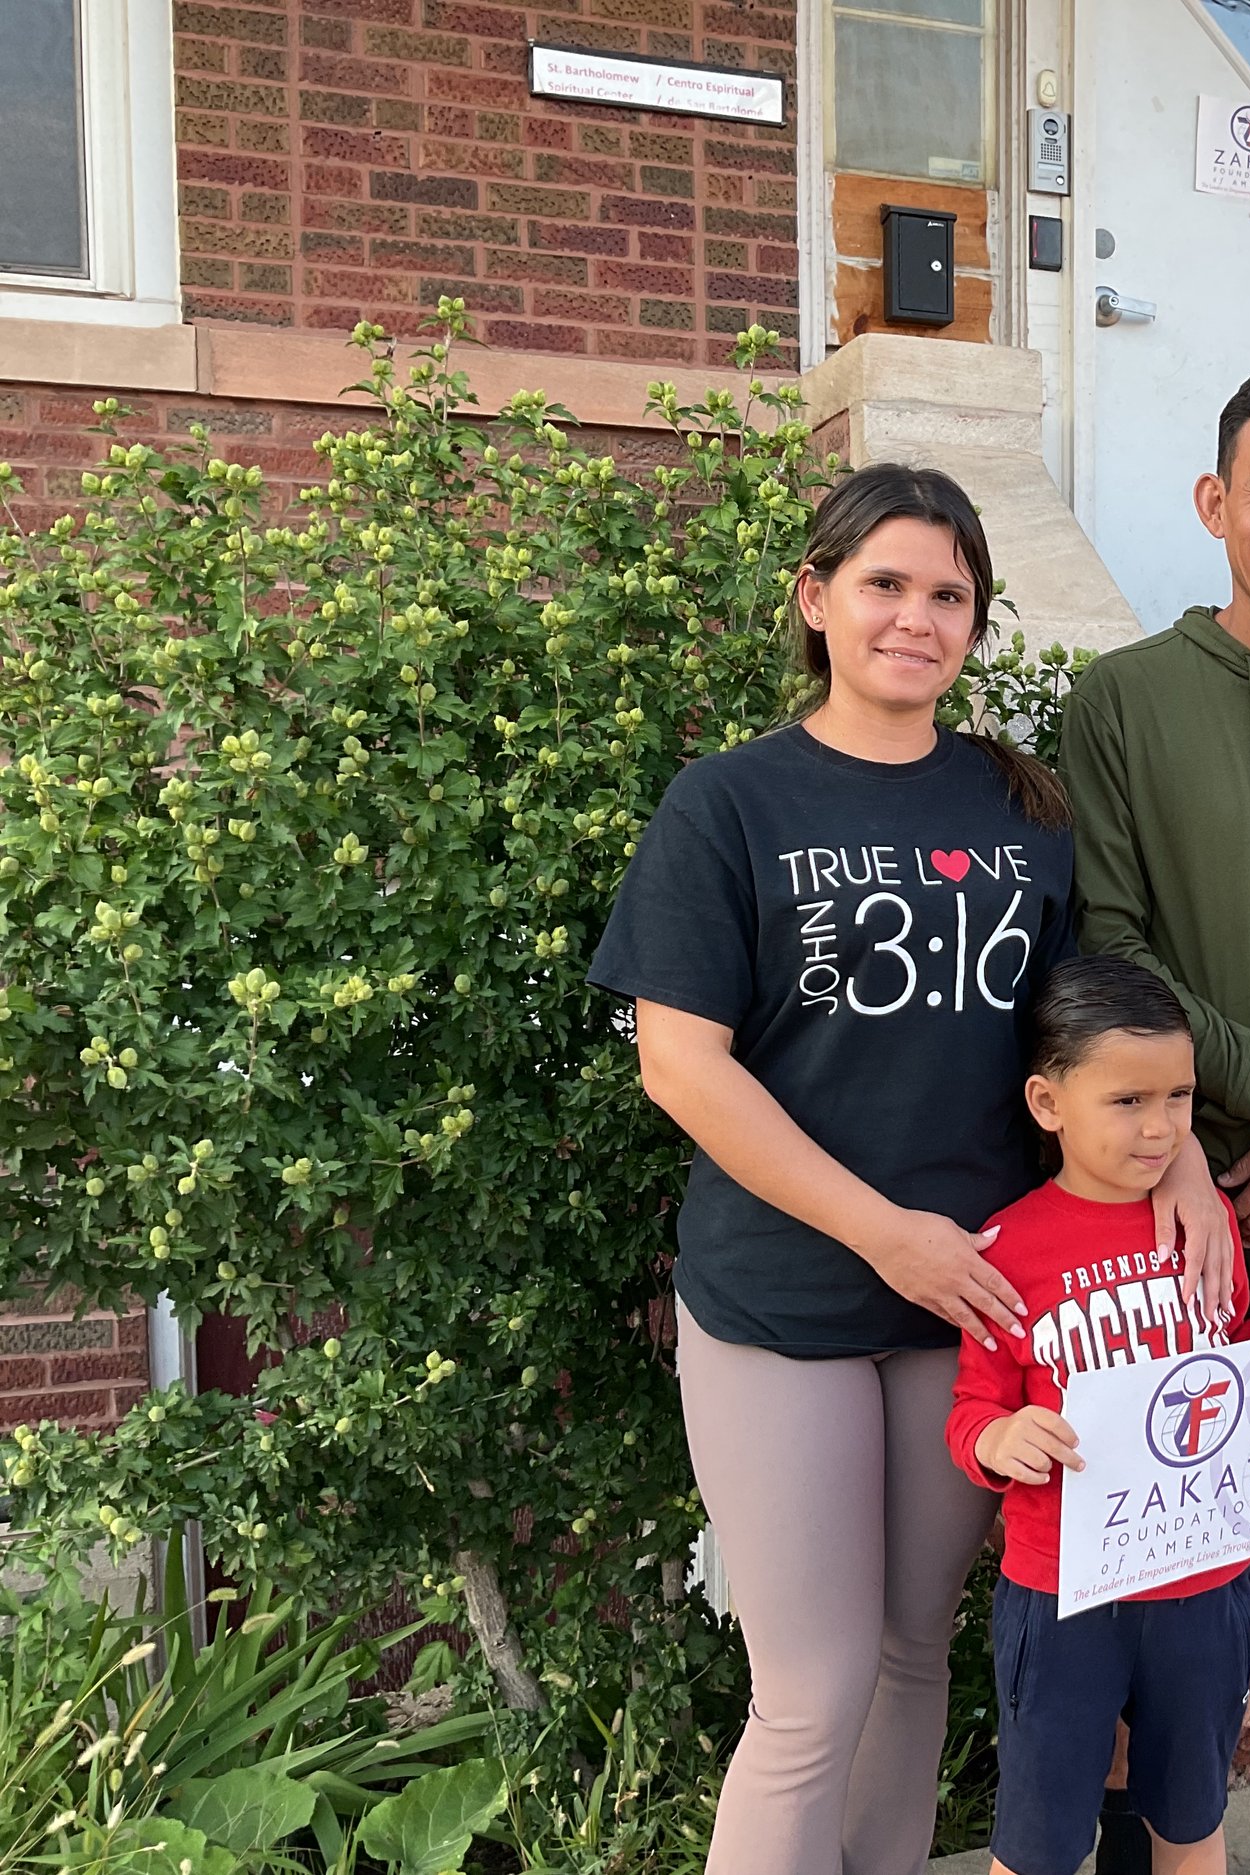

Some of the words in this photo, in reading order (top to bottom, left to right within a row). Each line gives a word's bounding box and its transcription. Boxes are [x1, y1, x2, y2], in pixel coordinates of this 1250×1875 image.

[547, 63, 562, 74] St.
[565, 65, 640, 83] Bartholomew
[667, 76, 703, 90] Centro
[706, 82, 755, 97] Espiritual
[548, 81, 594, 96] Spiritual
[779, 846, 901, 895] TRUE
[796, 900, 840, 1015] JOHN
[846, 889, 1030, 1015] 3:16
[1061, 1250, 1161, 1295] FRIENDS
[1073, 1588, 1090, 1602] The
[1091, 1578, 1124, 1597] Leader
[1125, 1573, 1136, 1586] in
[1137, 1556, 1195, 1583] Empowering
[1196, 1548, 1221, 1563] Lives
[1101, 1555, 1125, 1575] of
